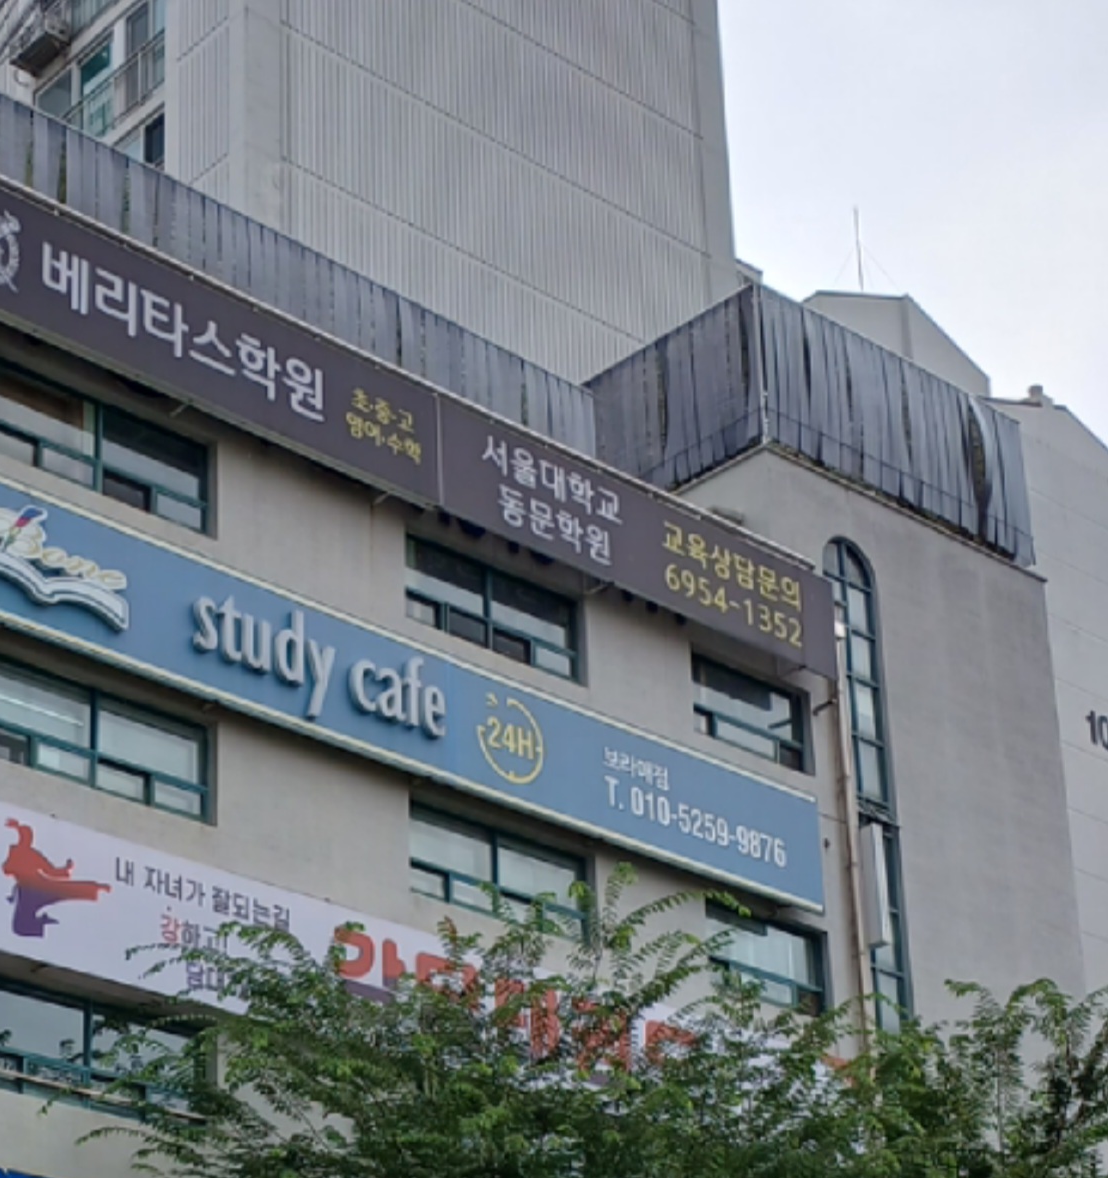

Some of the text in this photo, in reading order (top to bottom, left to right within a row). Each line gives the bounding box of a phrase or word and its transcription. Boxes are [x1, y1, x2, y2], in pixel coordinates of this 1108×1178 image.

[42, 242, 325, 422] 베리타스학원
[482, 433, 622, 525] 서울대학교
[498, 484, 613, 566] 동문학원
[661, 520, 803, 611] 교육상담문의
[665, 564, 803, 648] 6954-1352
[194, 594, 447, 738] study cafe
[487, 717, 535, 760] 24H
[603, 747, 669, 790] 보라매점
[116, 857, 134, 887] 내
[144, 866, 206, 907] 자녀가
